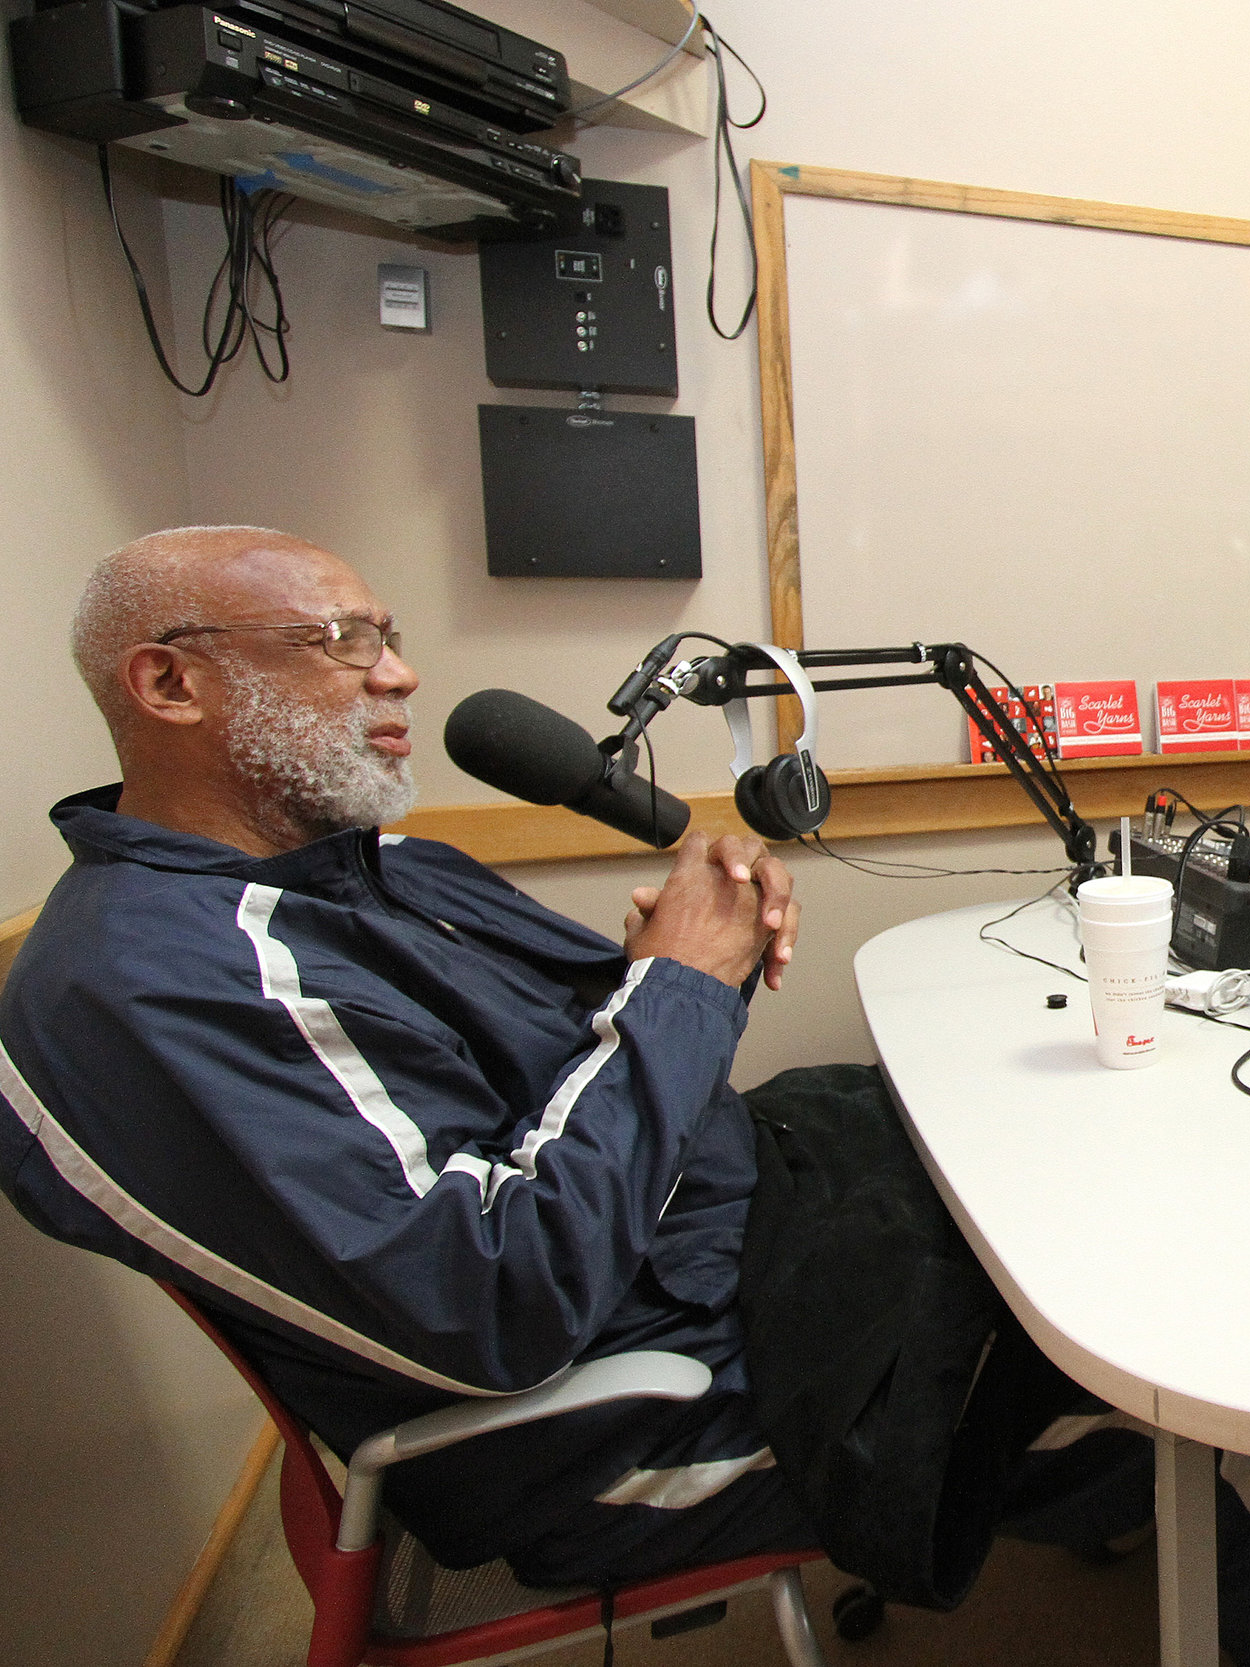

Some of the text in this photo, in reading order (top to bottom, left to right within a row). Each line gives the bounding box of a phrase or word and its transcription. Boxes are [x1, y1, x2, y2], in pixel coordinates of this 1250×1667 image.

[213, 15, 257, 39] Panasonic
[1078, 694, 1124, 711] Scarlet
[1178, 693, 1222, 709] Scarlet
[1060, 707, 1076, 719] BIG
[1083, 708, 1136, 734] Yarns
[1182, 708, 1232, 732] Yarns
